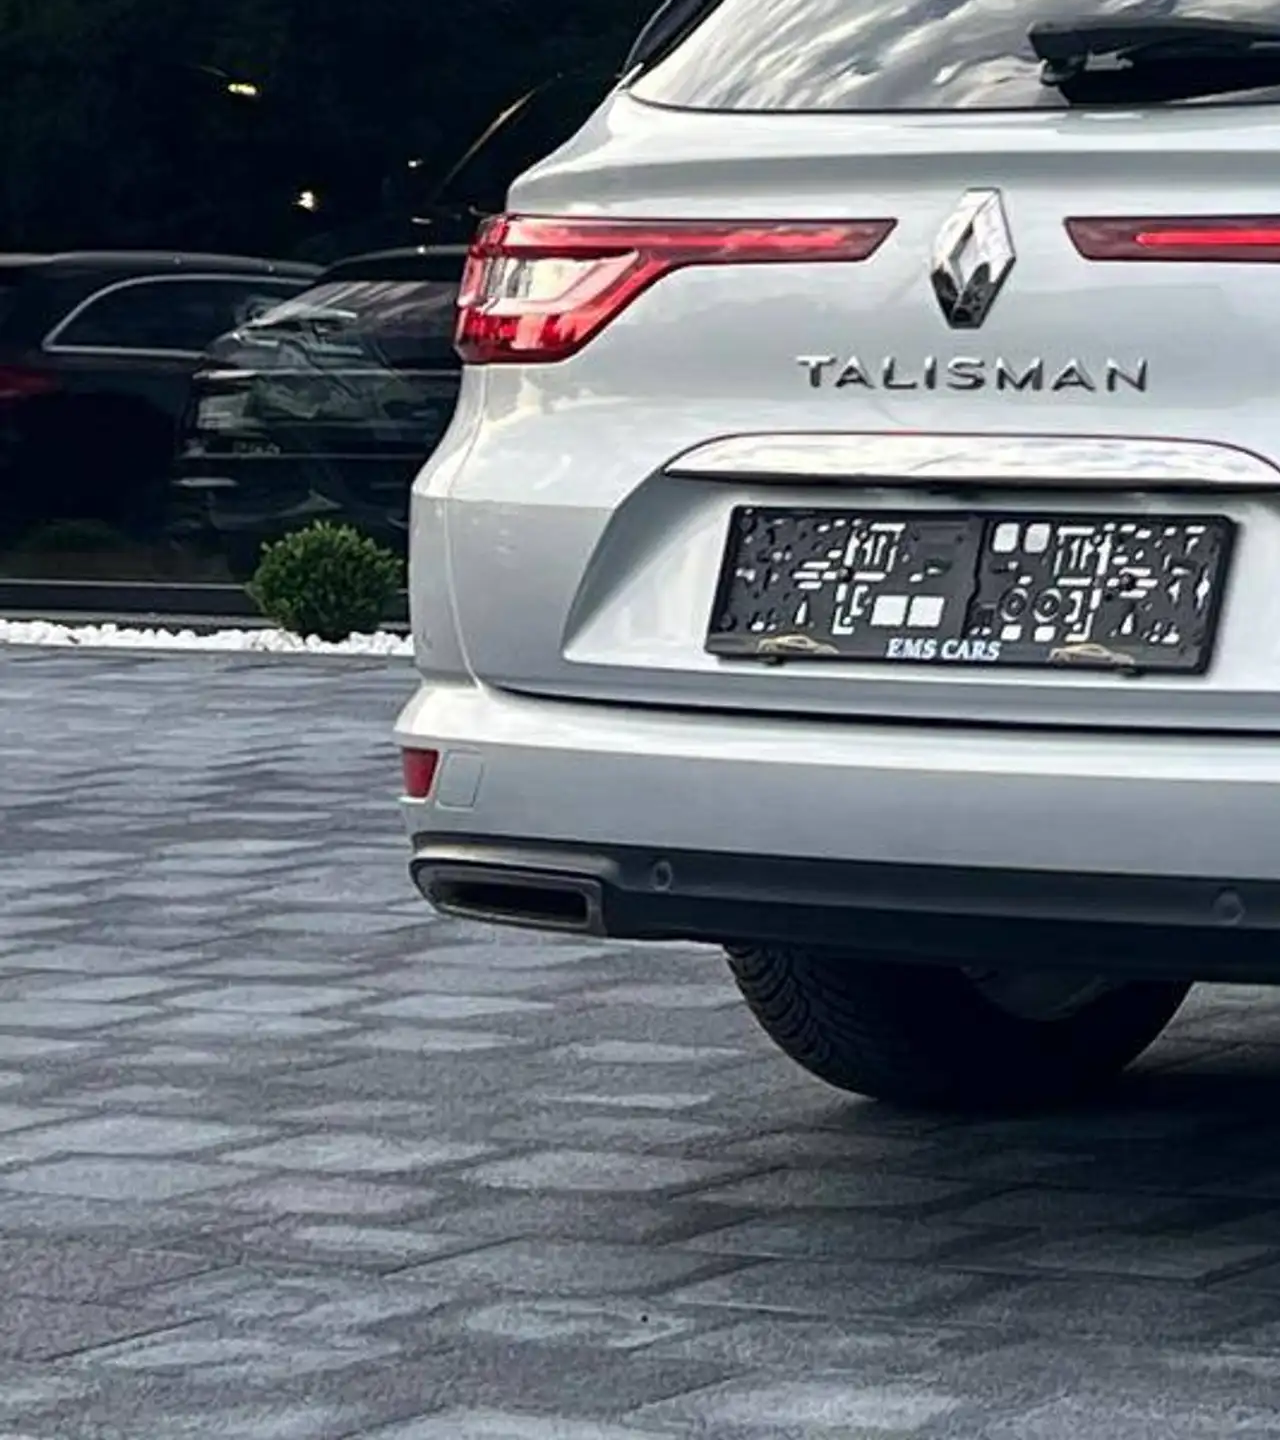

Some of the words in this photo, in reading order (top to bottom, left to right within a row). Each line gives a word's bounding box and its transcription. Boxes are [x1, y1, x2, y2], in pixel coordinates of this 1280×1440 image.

[797, 354, 1148, 392] TALISMAN
[886, 638, 937, 660] EMS
[940, 639, 1002, 661] CARS
